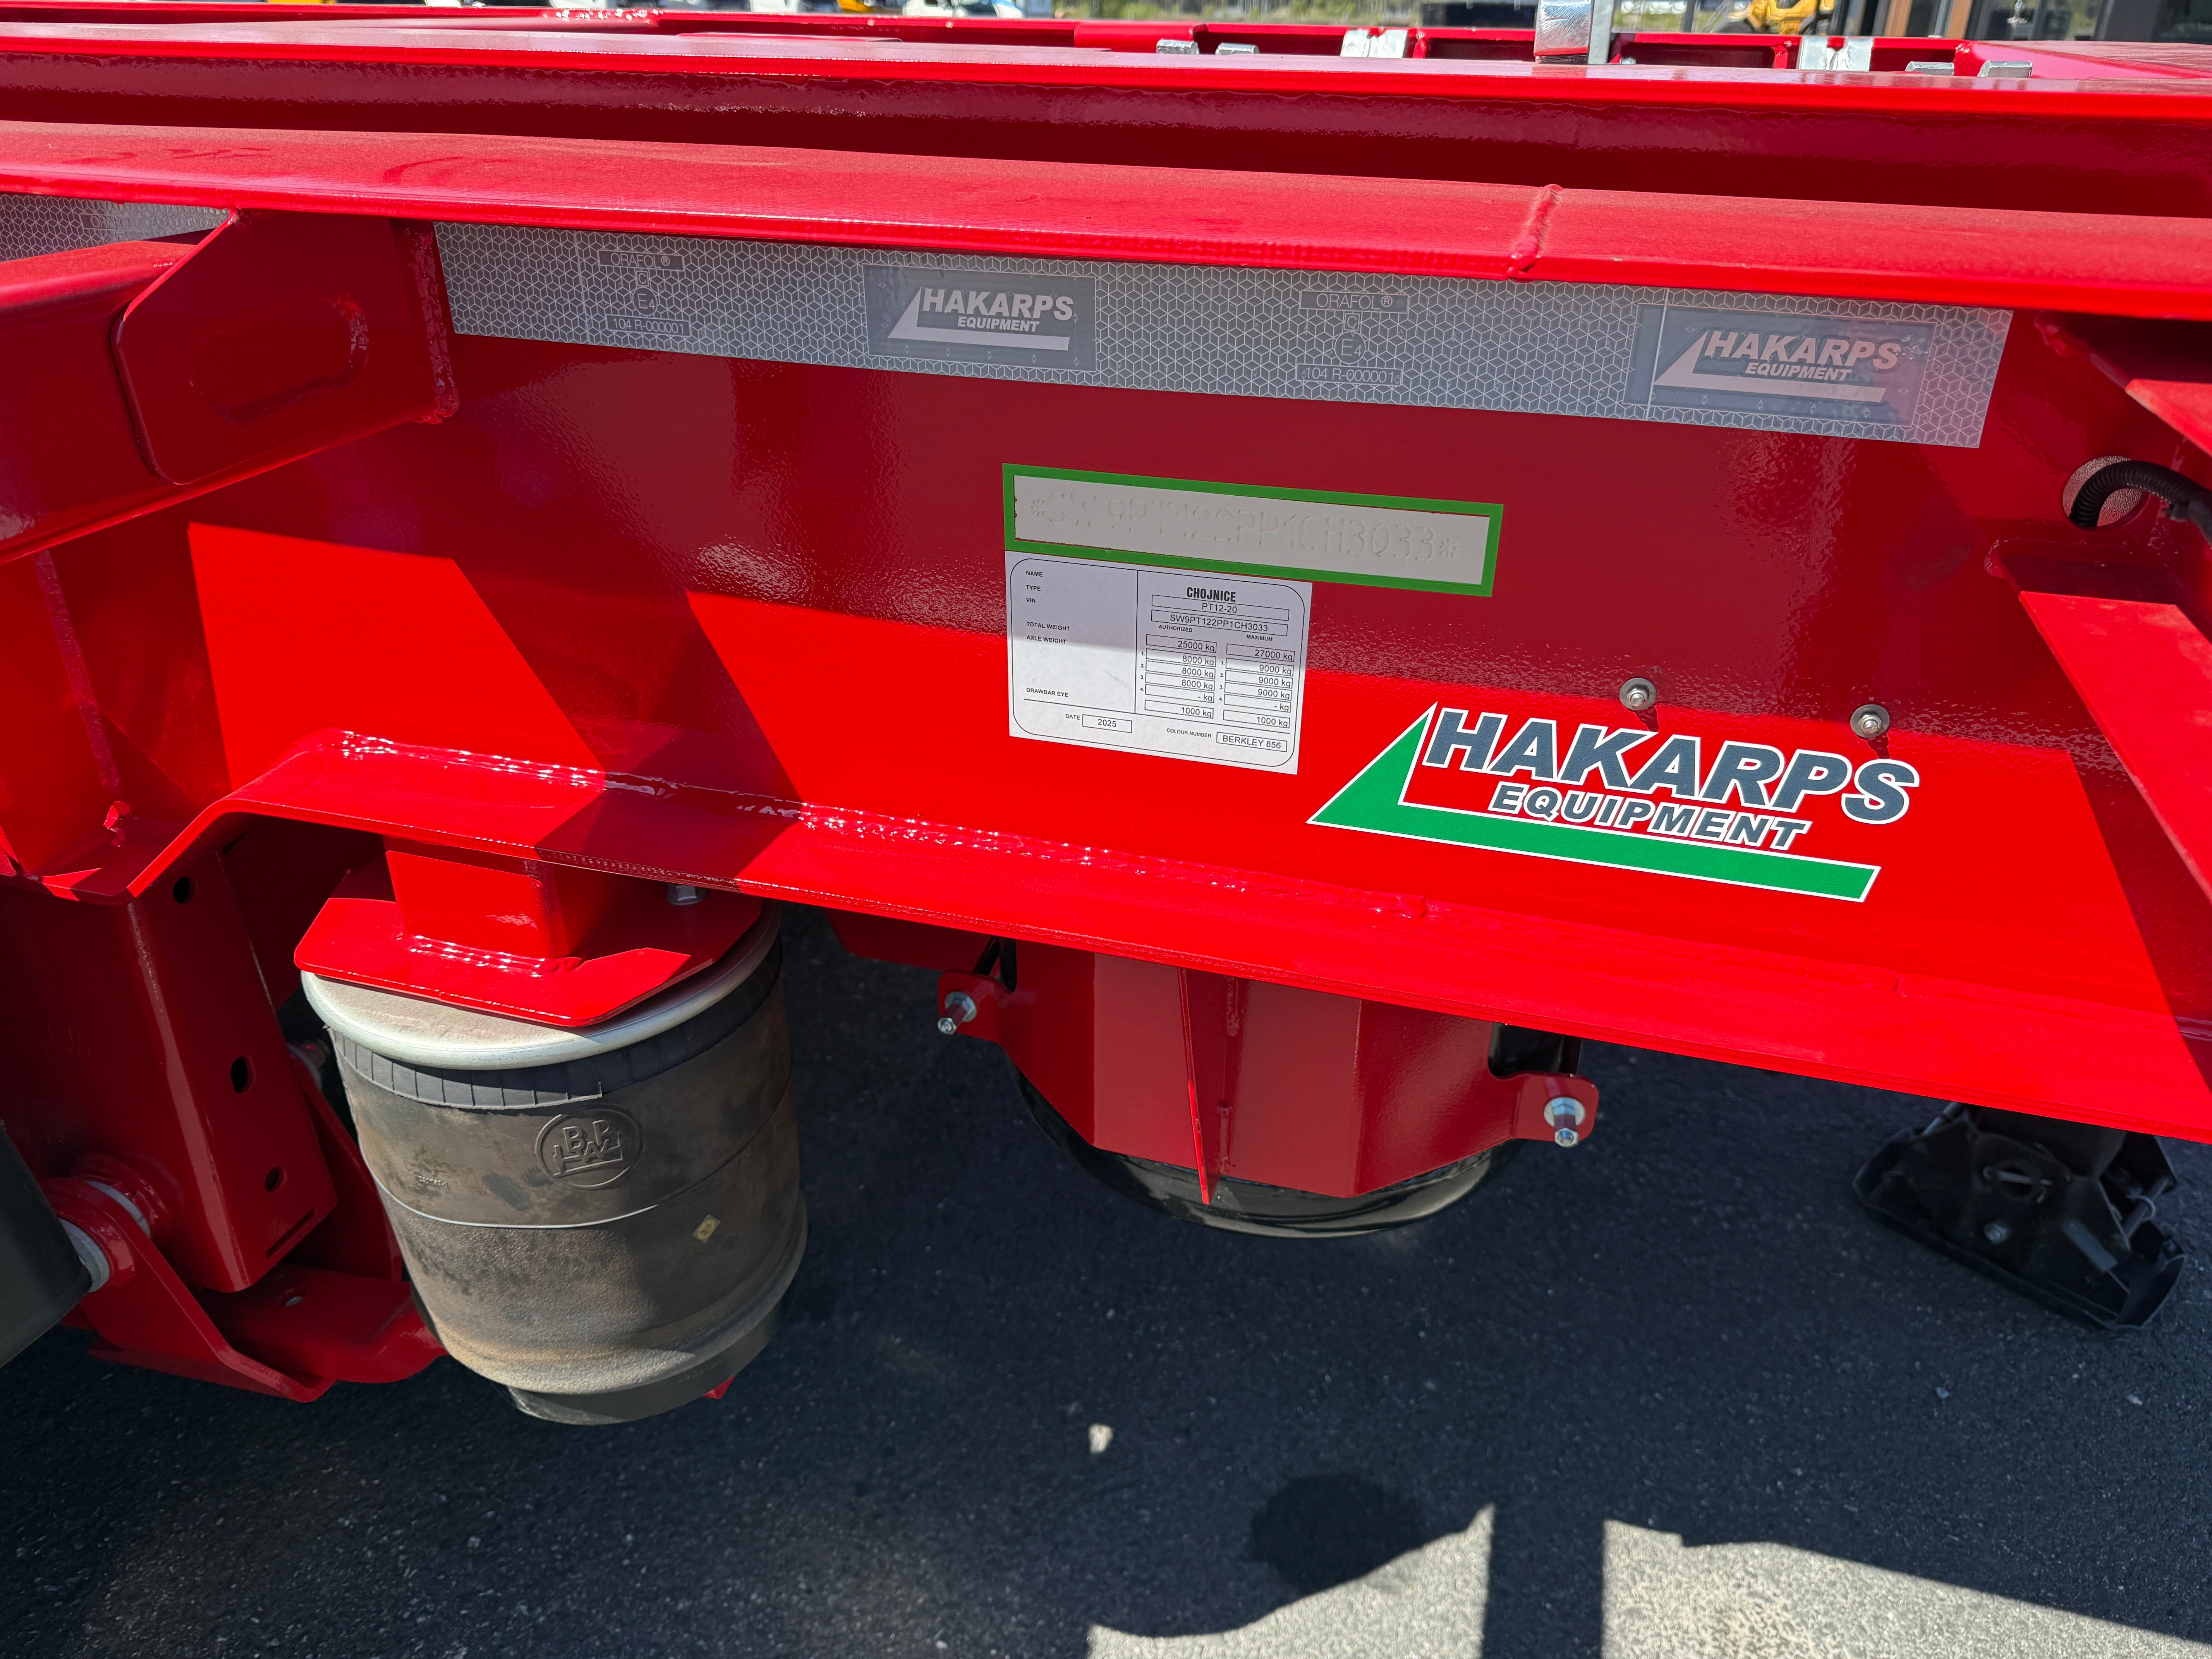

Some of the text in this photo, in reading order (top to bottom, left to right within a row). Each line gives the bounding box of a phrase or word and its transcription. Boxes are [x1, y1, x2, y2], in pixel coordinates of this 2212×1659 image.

[922, 288, 1074, 321] HAKARPS
[613, 318, 684, 334] 104 R-000001
[957, 316, 1040, 332] EQUIPMENT
[1704, 331, 1902, 369] HAKARPS
[1306, 367, 1394, 383] 104 R-000001
[1745, 362, 1852, 381] EQUIPMENT
[1187, 587, 1236, 602] CHOJNICE
[1202, 603, 1237, 613] PT12-20
[1170, 614, 1268, 632] SW9PT122PP1CH3033
[1178, 640, 1215, 652] 25000 kg
[1182, 655, 1202, 664] 8000
[1205, 658, 1214, 666] kg
[1255, 649, 1293, 661] 27000 kg
[1182, 667, 1202, 676] 8000
[1204, 670, 1213, 678] kg
[1259, 665, 1279, 673] 9000
[1282, 667, 1291, 675] kg
[1182, 680, 1201, 688] 8000
[1204, 682, 1213, 690] kg
[1259, 677, 1279, 685] 9000
[1281, 679, 1291, 687] kg
[1026, 687, 1055, 696] DRAWBAR
[1258, 689, 1278, 697] 9000
[1281, 691, 1290, 699] kg
[1204, 694, 1212, 702] kg
[1181, 707, 1211, 718] 1000 kg
[1280, 703, 1289, 711] kg
[1097, 719, 1117, 727] 2025
[1257, 716, 1288, 727] 1000 kg
[1223, 735, 1264, 746] BERKLEY
[1422, 707, 1920, 824] HAKARPS
[1488, 781, 1812, 851] EQUIPMENT
